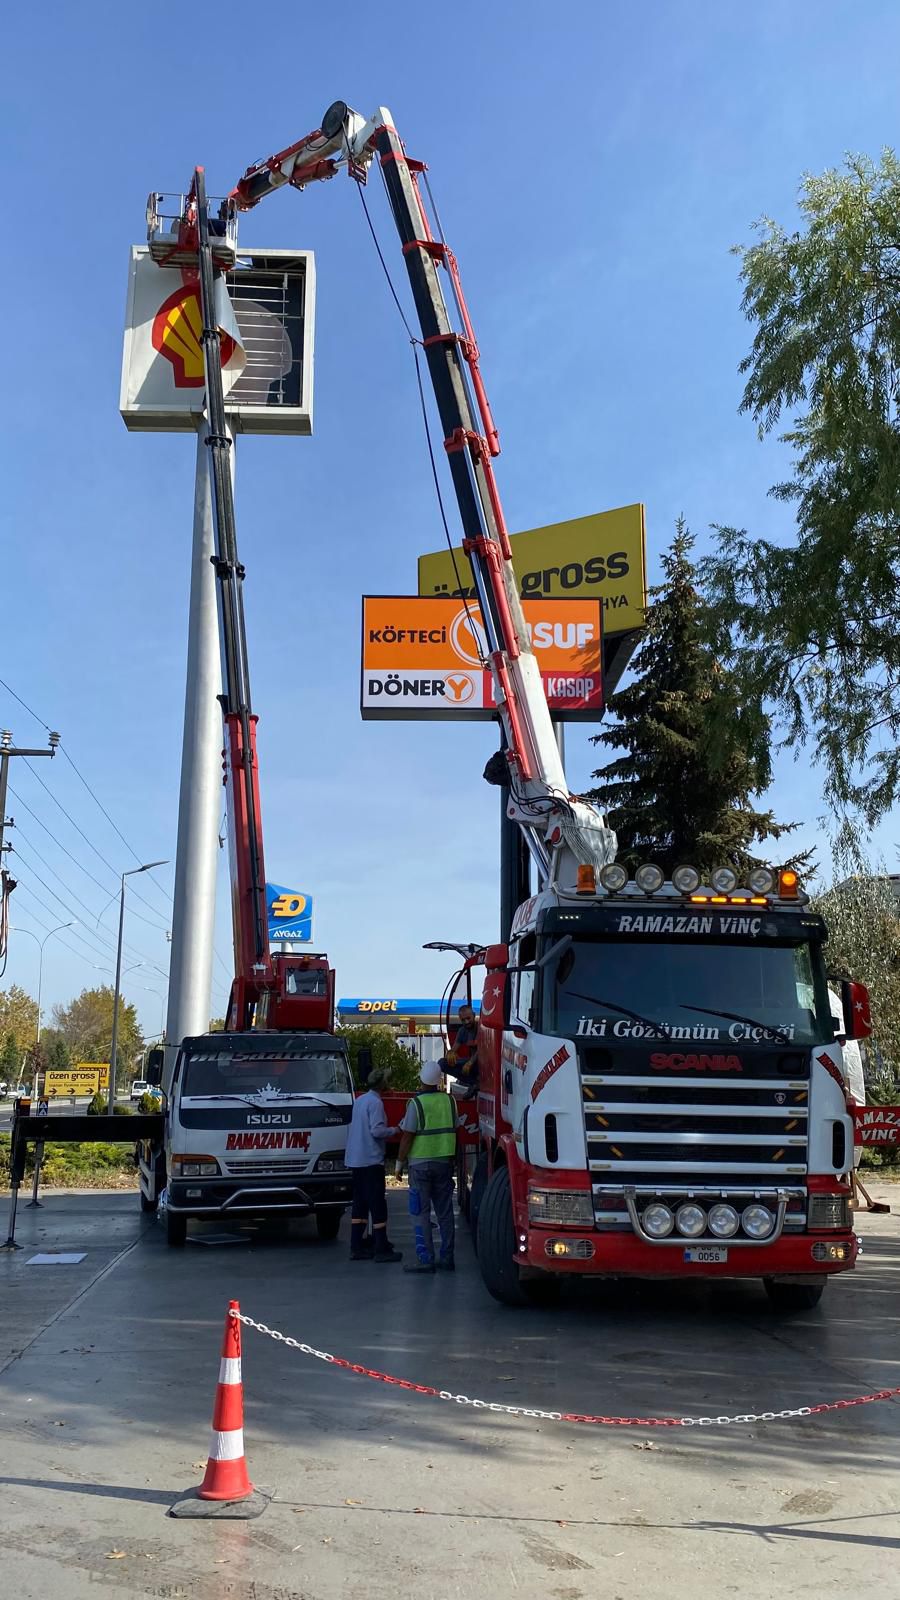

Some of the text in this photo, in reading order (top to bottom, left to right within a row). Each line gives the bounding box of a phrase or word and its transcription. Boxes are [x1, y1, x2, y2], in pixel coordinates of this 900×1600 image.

[521, 552, 630, 597] gross
[369, 622, 594, 649] KÖFTECİ SUF
[368, 674, 446, 696] DÖNER
[548, 678, 594, 701] KASAP
[618, 915, 713, 934] RAMAZAN
[273, 930, 302, 938] AYGAZ
[358, 1000, 398, 1013] opet
[575, 1015, 606, 1036] İki
[728, 1022, 795, 1045] Çiçeği
[650, 1053, 743, 1072] SCANIA
[49, 1071, 69, 1080] özen
[71, 1073, 95, 1081] gross
[247, 1114, 291, 1125] ISUZU
[226, 1132, 285, 1150] RAMAZAN
[861, 1128, 898, 1142] VİNÇ
[698, 1252, 720, 1261] 0056
